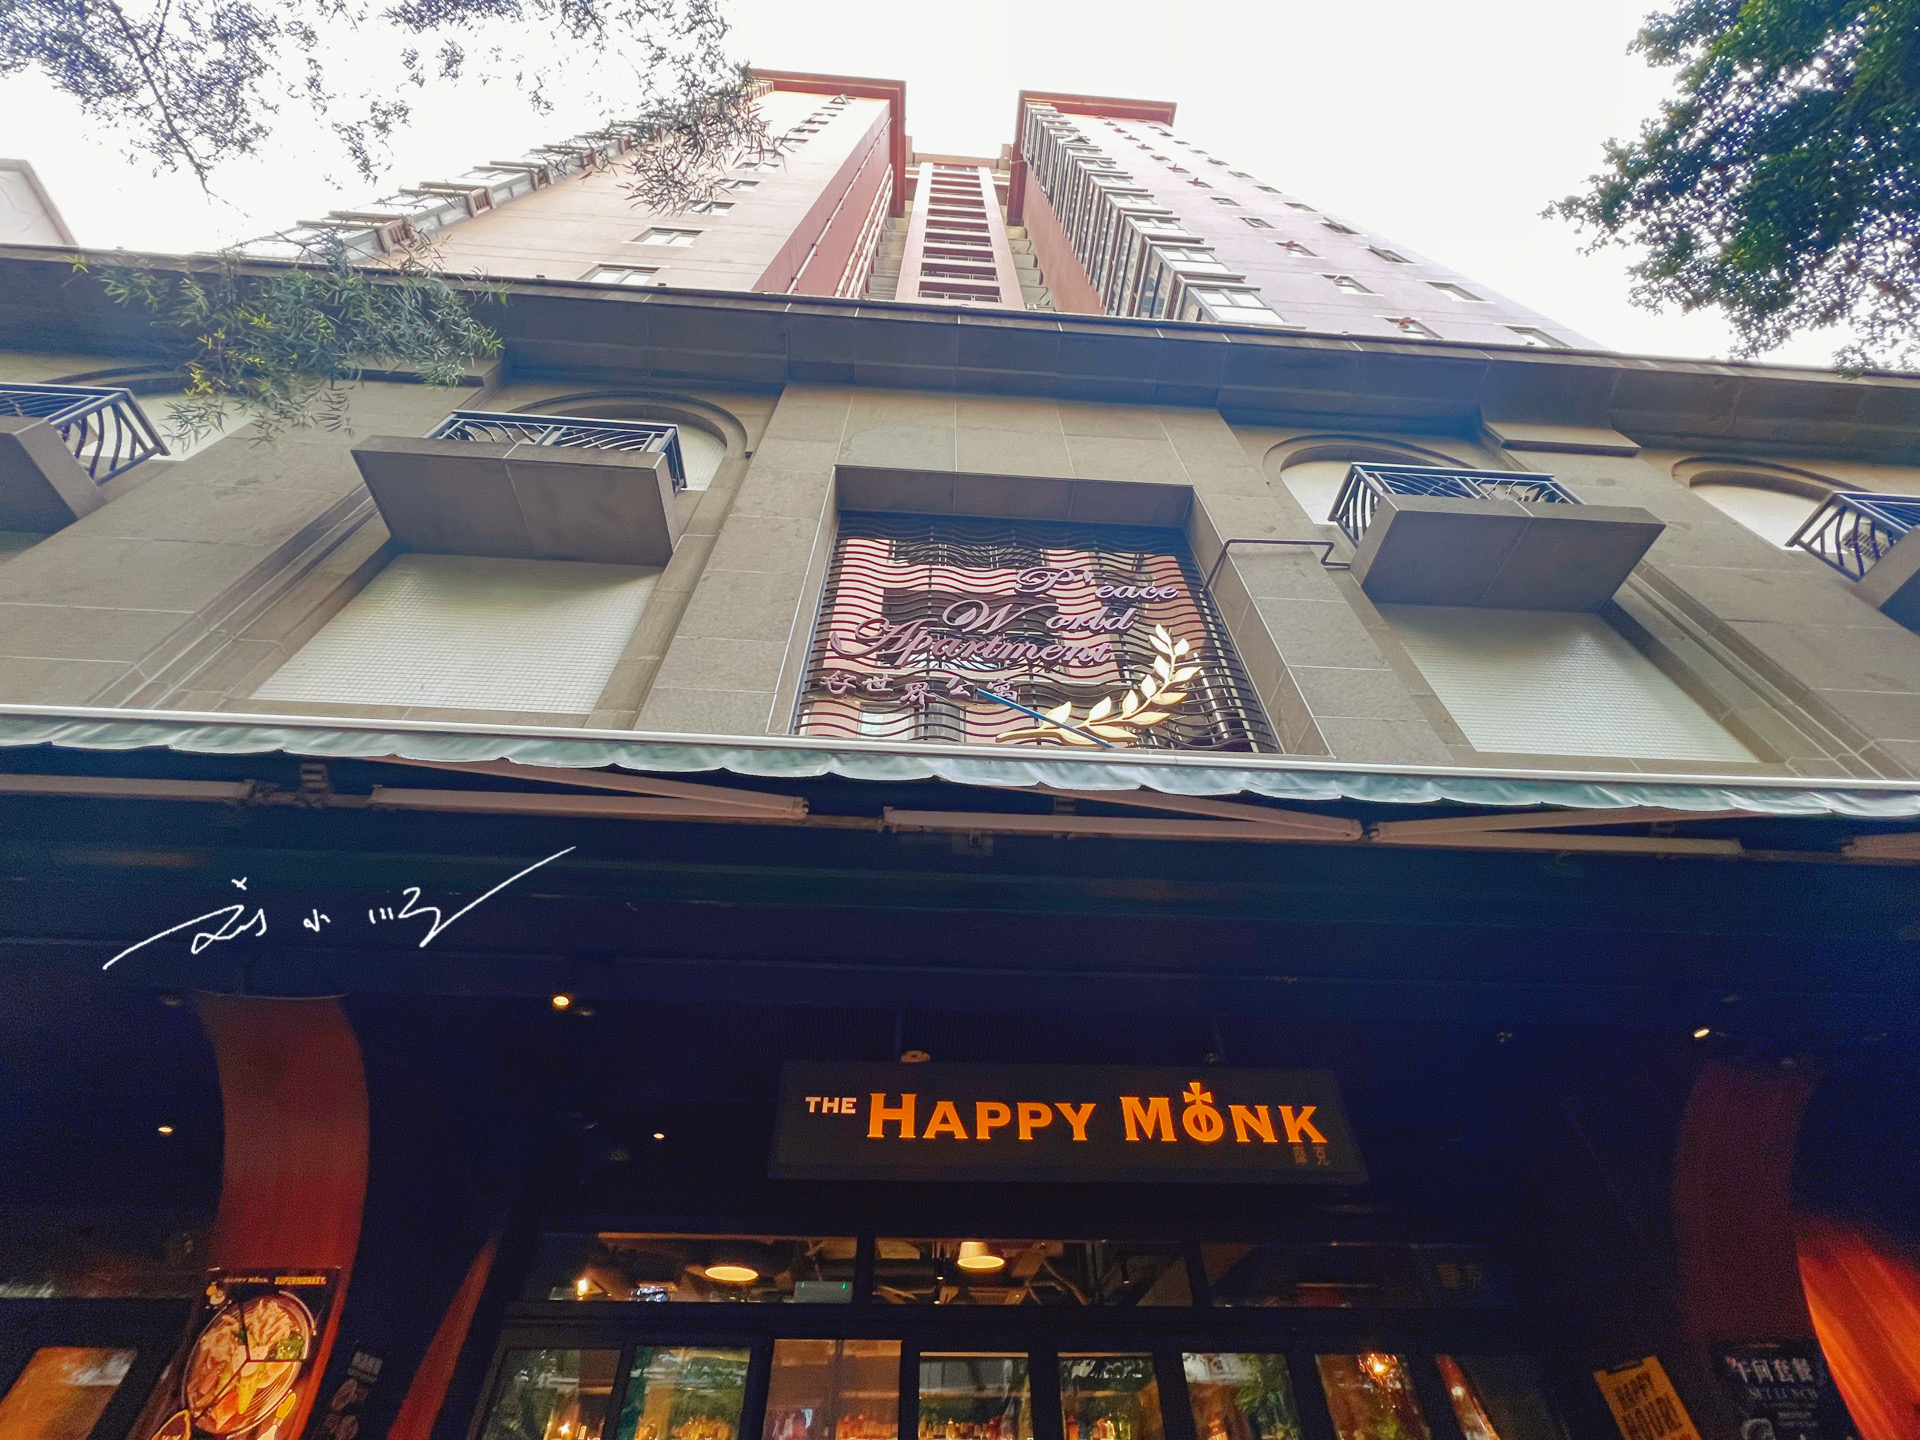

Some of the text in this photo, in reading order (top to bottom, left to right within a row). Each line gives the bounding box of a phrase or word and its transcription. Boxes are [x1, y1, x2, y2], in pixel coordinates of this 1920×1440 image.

[1014, 565, 1180, 600] Peace
[942, 599, 1137, 635] World
[830, 617, 1115, 667] Apartment
[819, 669, 1019, 706] 好世界公寓
[804, 1081, 1329, 1144] THE HAPPY MONK
